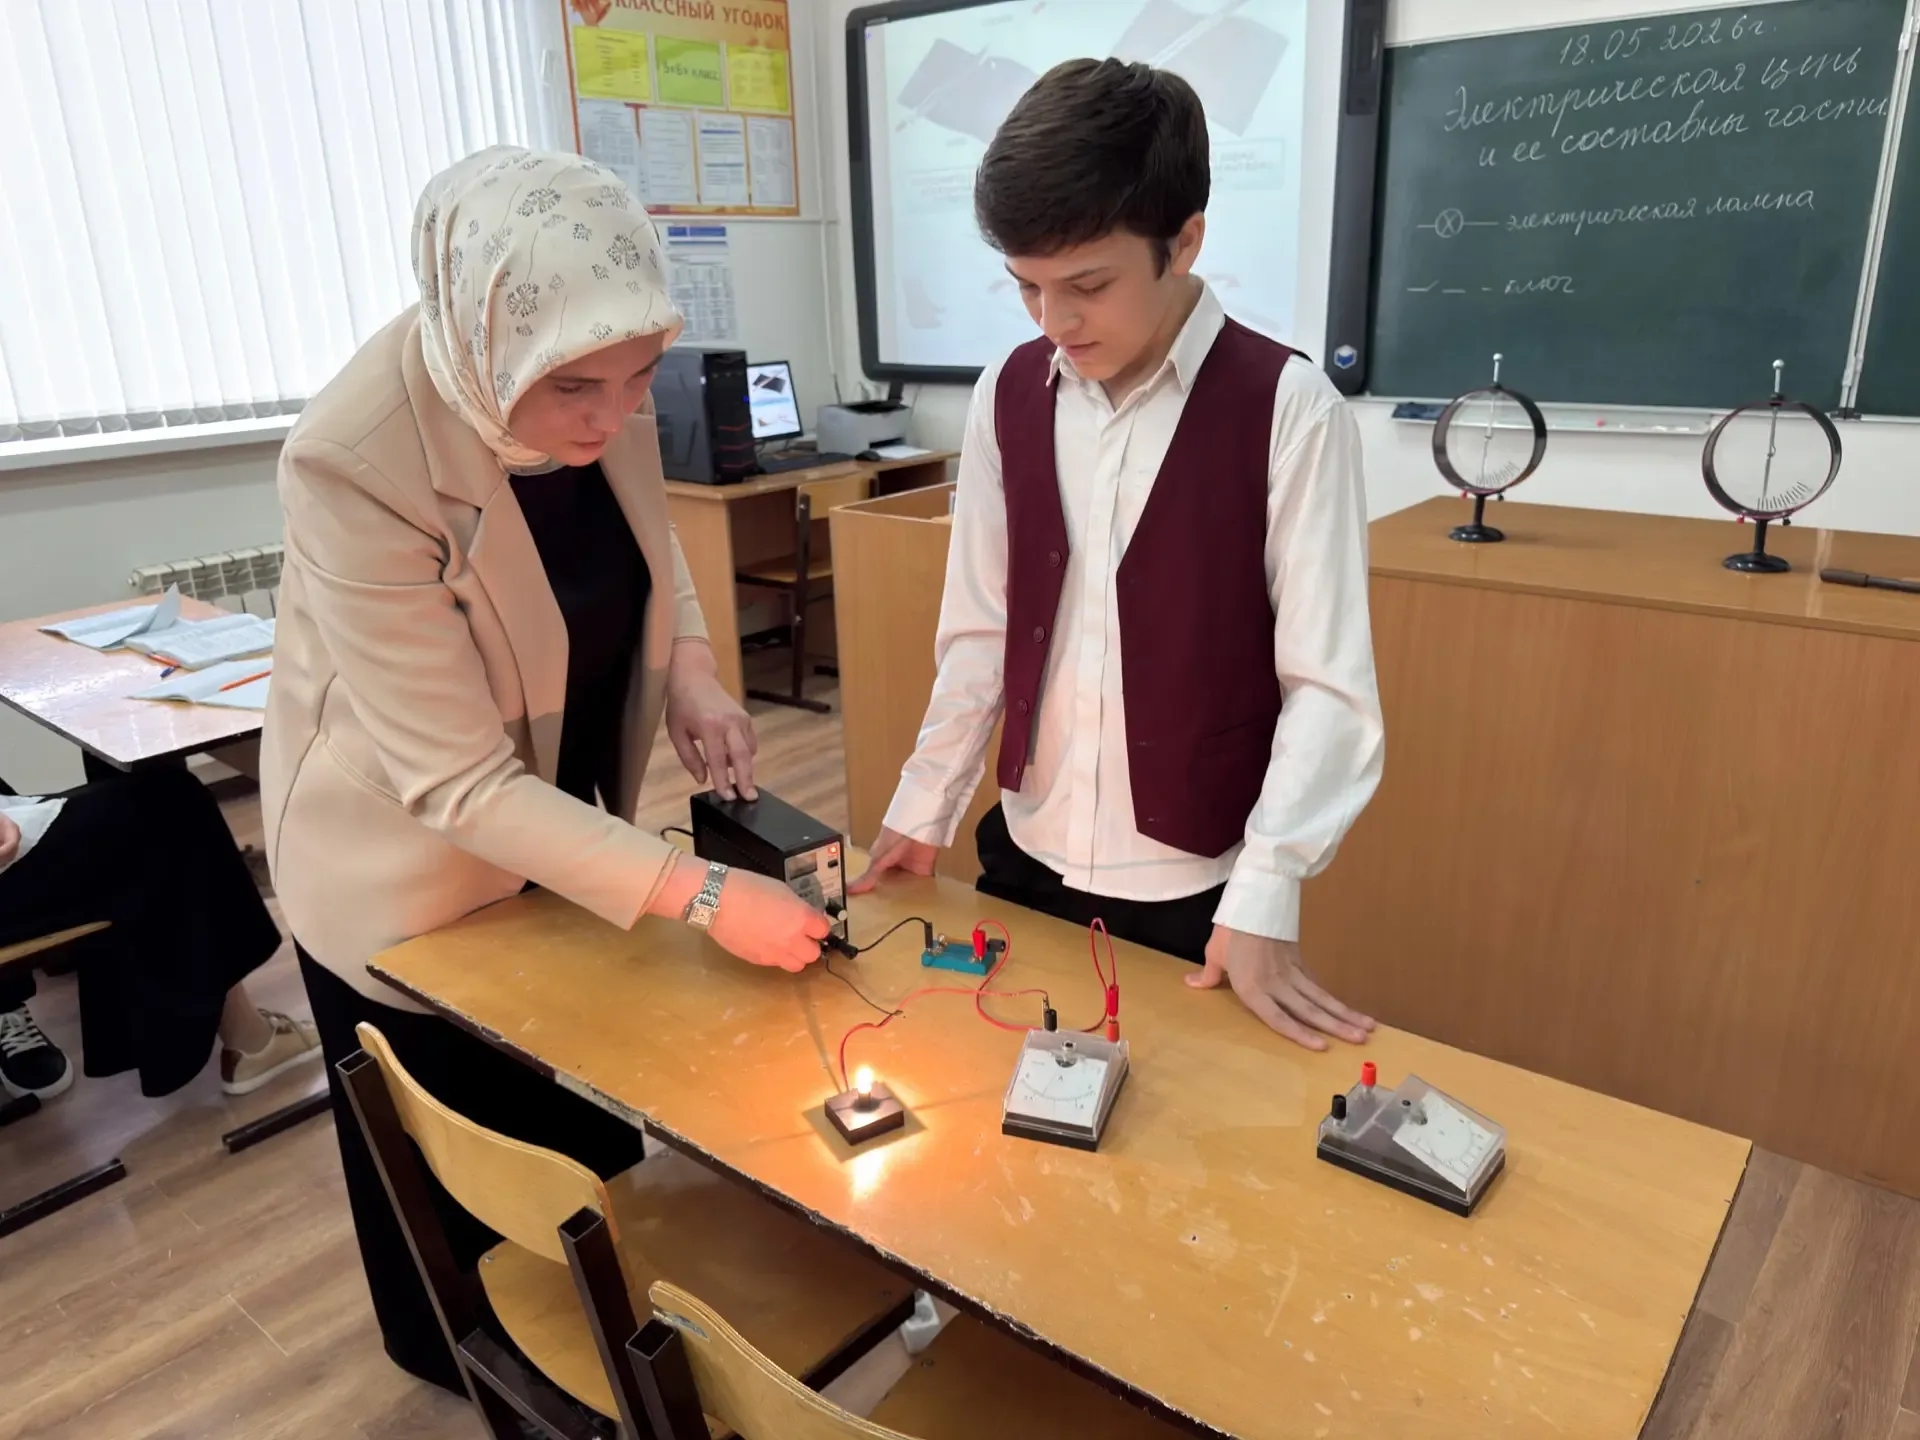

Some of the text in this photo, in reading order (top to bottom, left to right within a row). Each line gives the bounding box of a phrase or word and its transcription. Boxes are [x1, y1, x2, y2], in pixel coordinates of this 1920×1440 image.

[722, 7, 784, 31] УГОЛОК
[1444, 62, 1746, 138] Электрическая
[1479, 146, 1496, 167] и
[1512, 140, 1547, 162] ее
[1505, 189, 1815, 236] электрическая лампа
